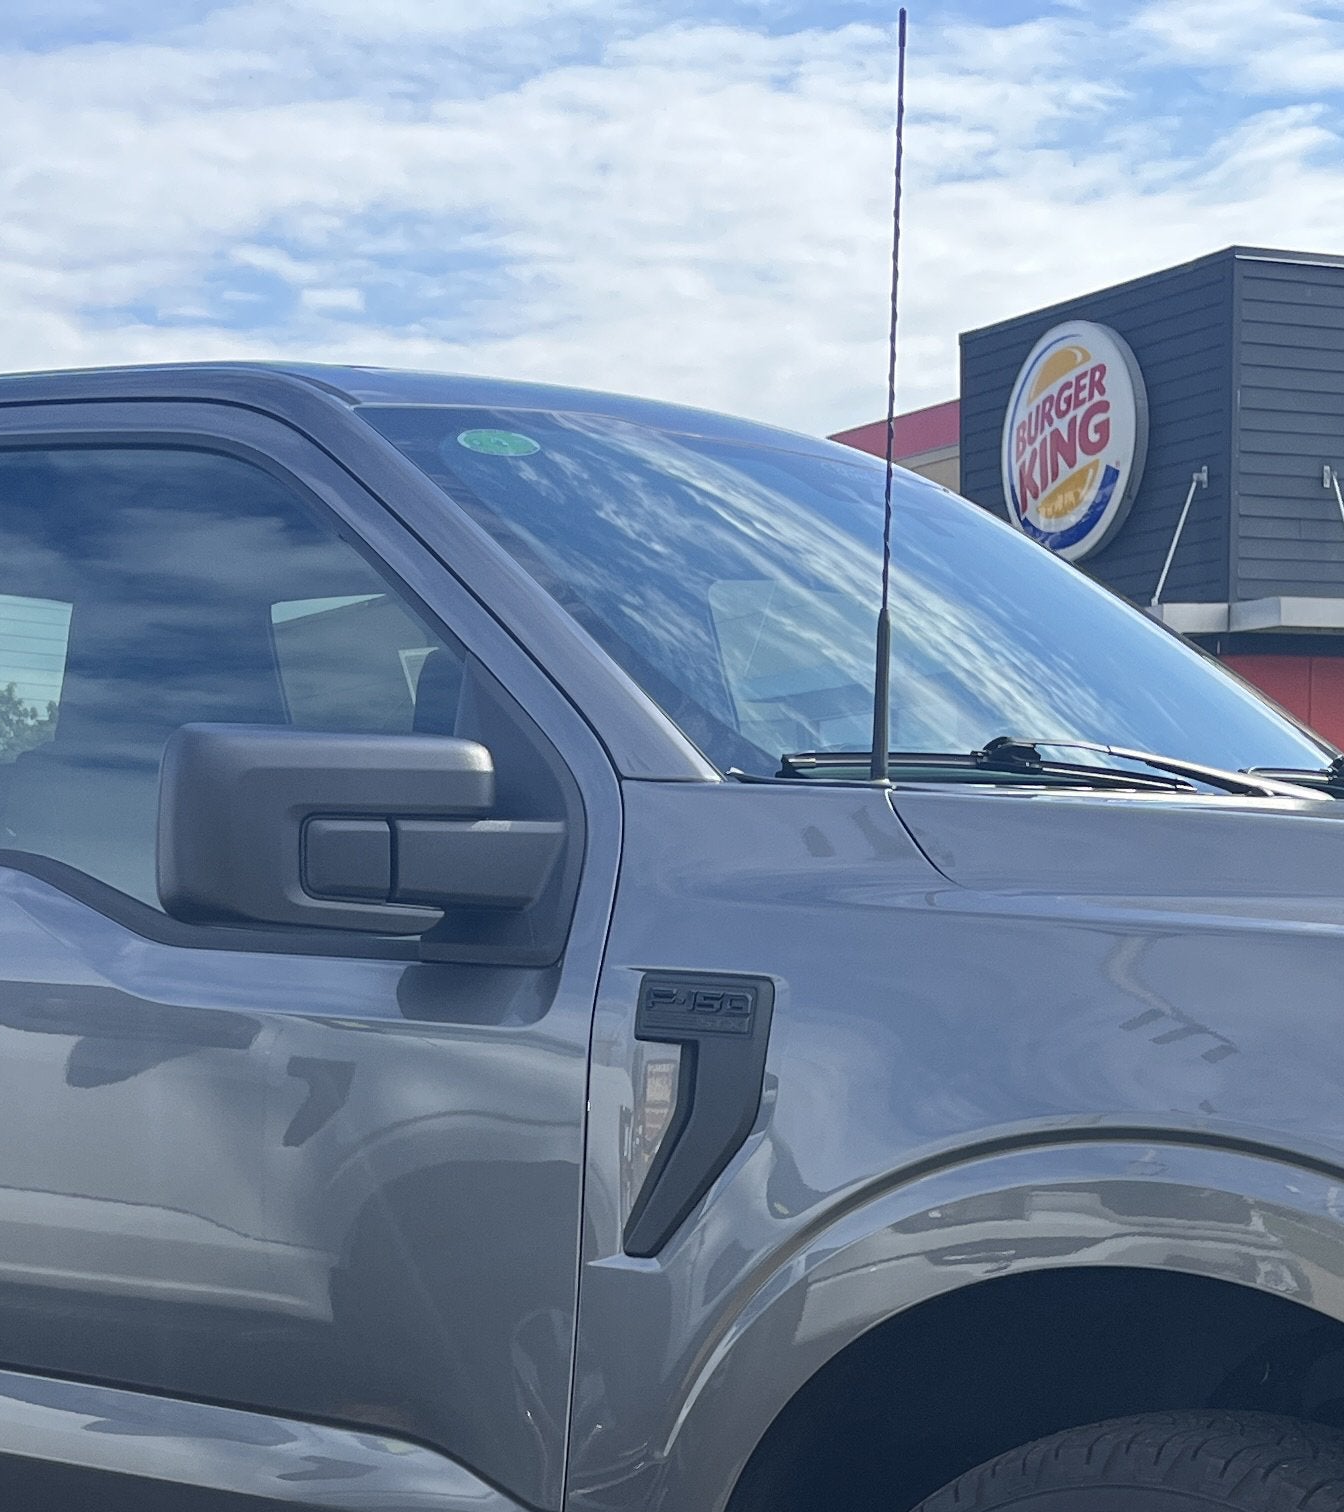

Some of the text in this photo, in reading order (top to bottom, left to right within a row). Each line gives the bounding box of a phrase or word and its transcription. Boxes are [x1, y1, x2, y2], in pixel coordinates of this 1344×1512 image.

[1015, 362, 1107, 464] BURGER
[1018, 399, 1111, 515] KING
[645, 986, 753, 1017] F-150
